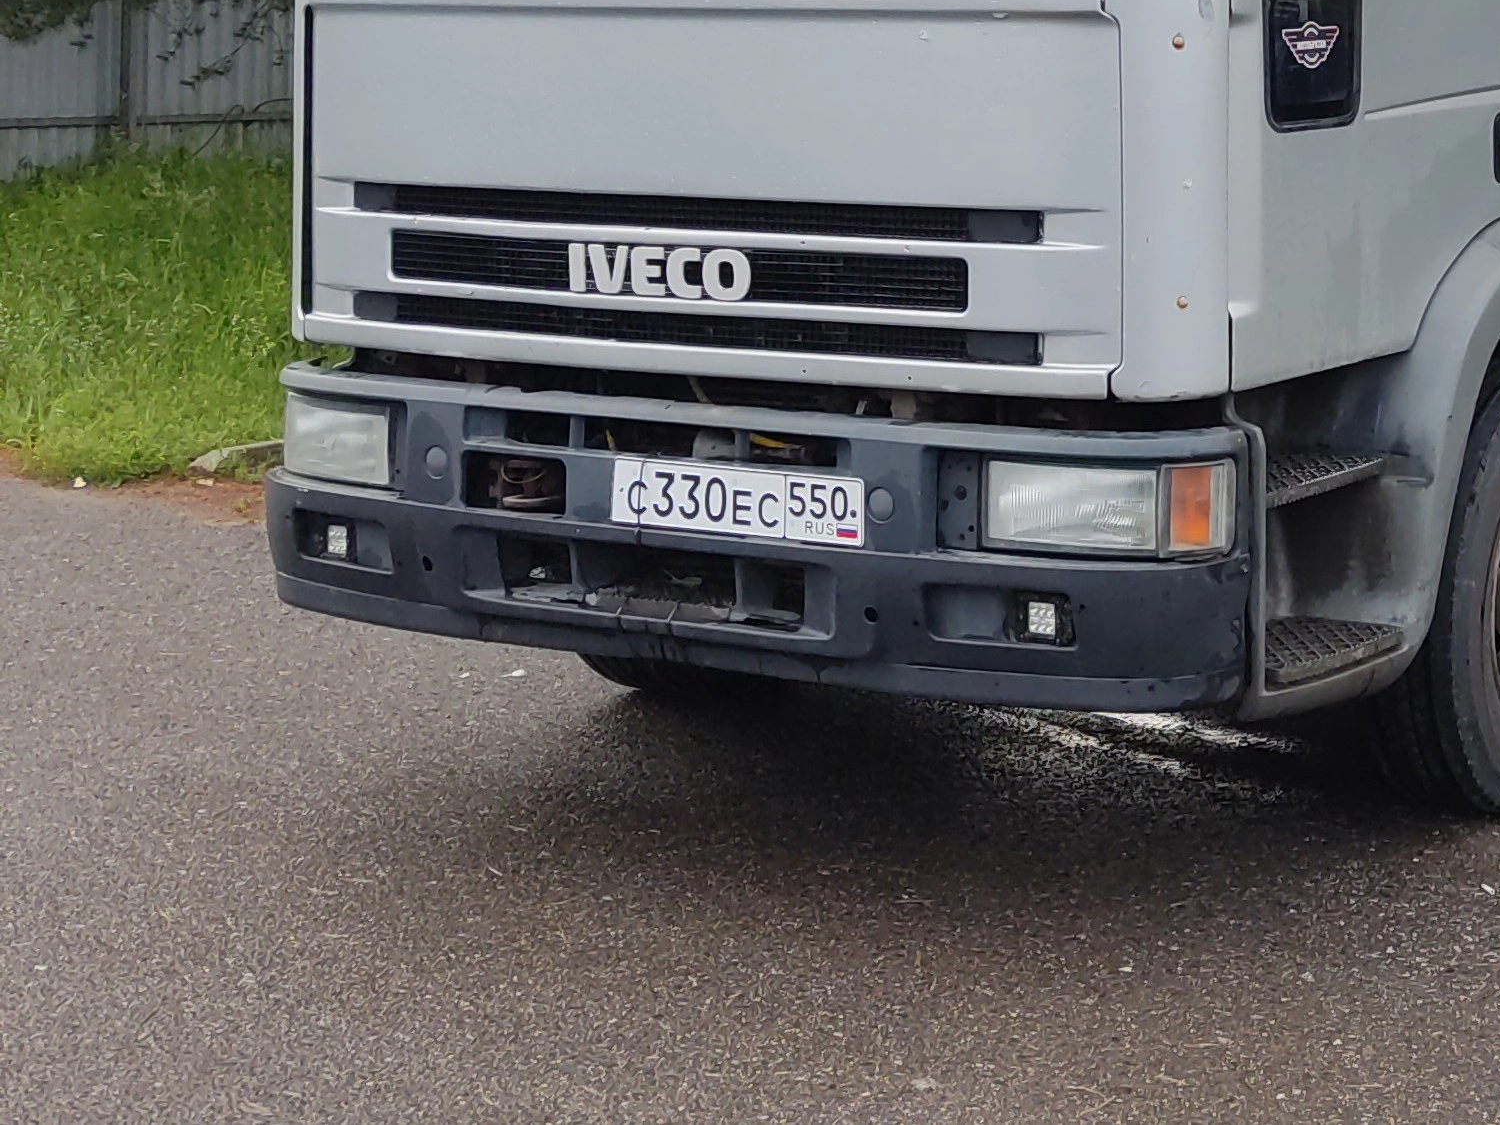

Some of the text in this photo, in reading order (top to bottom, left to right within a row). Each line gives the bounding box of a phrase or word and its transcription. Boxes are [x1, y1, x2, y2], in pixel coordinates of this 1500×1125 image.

[568, 242, 752, 301] IVECO
[788, 482, 848, 521] 550
[804, 522, 834, 536] RUS
